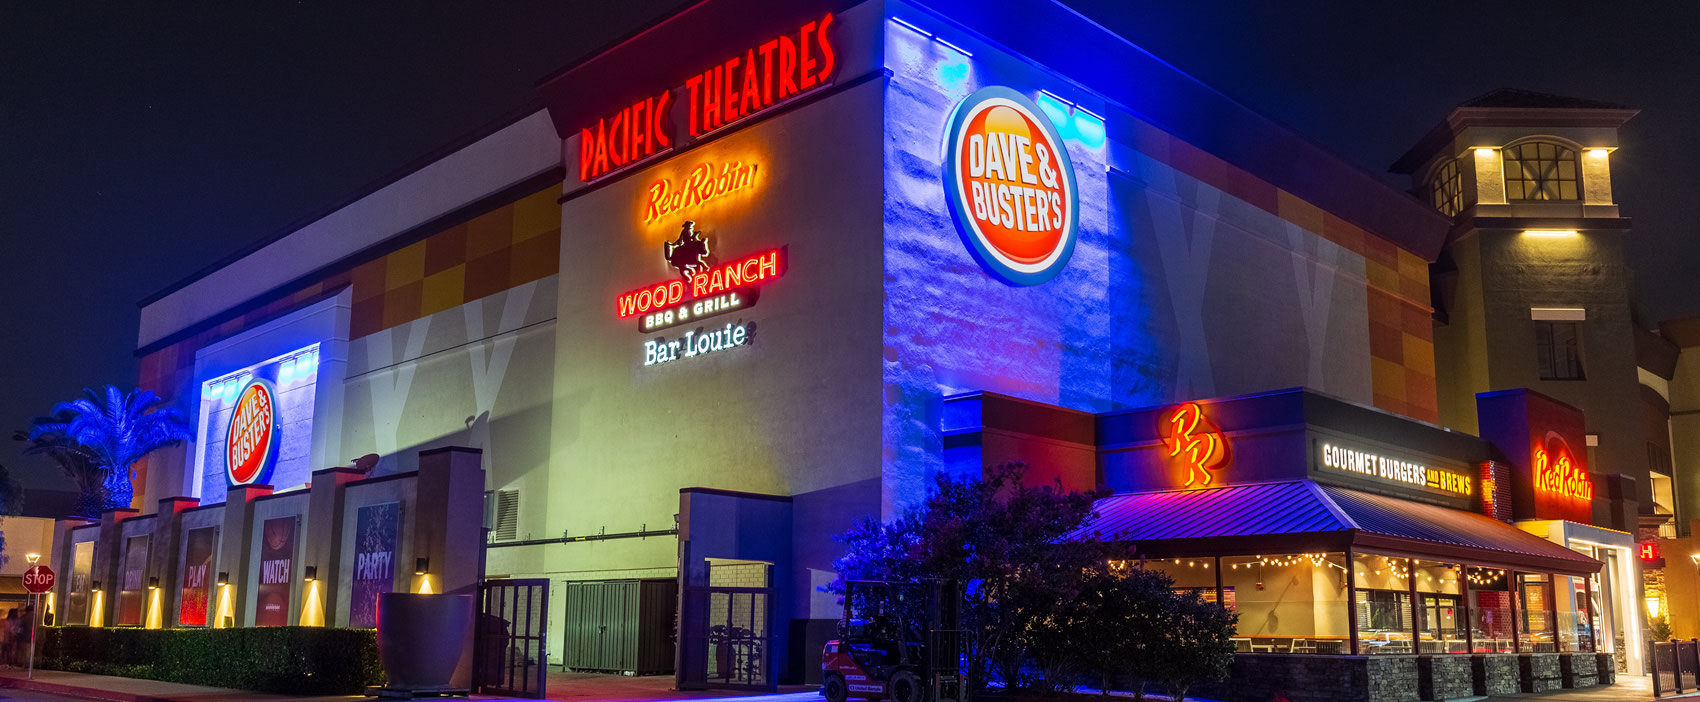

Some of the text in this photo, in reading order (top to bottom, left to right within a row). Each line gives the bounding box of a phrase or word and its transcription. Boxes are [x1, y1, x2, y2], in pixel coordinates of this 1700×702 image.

[580, 12, 835, 182] PACIFIC THEATRES
[970, 132, 1059, 189] DAVE &
[971, 180, 1062, 232] BUSTER'S
[618, 252, 777, 317] WOOD RANCH
[645, 293, 740, 329] BBQ & GRILL
[644, 323, 746, 366] Bar Louie
[232, 389, 267, 446] DAVE &
[232, 405, 269, 471] BUSTER'S
[1323, 443, 1472, 496] GOURMET BURGERS AND BREWS
[25, 573, 54, 585] STOP
[188, 565, 207, 588] PLAY
[263, 559, 290, 585] WATCH
[357, 551, 392, 580] PARTY
